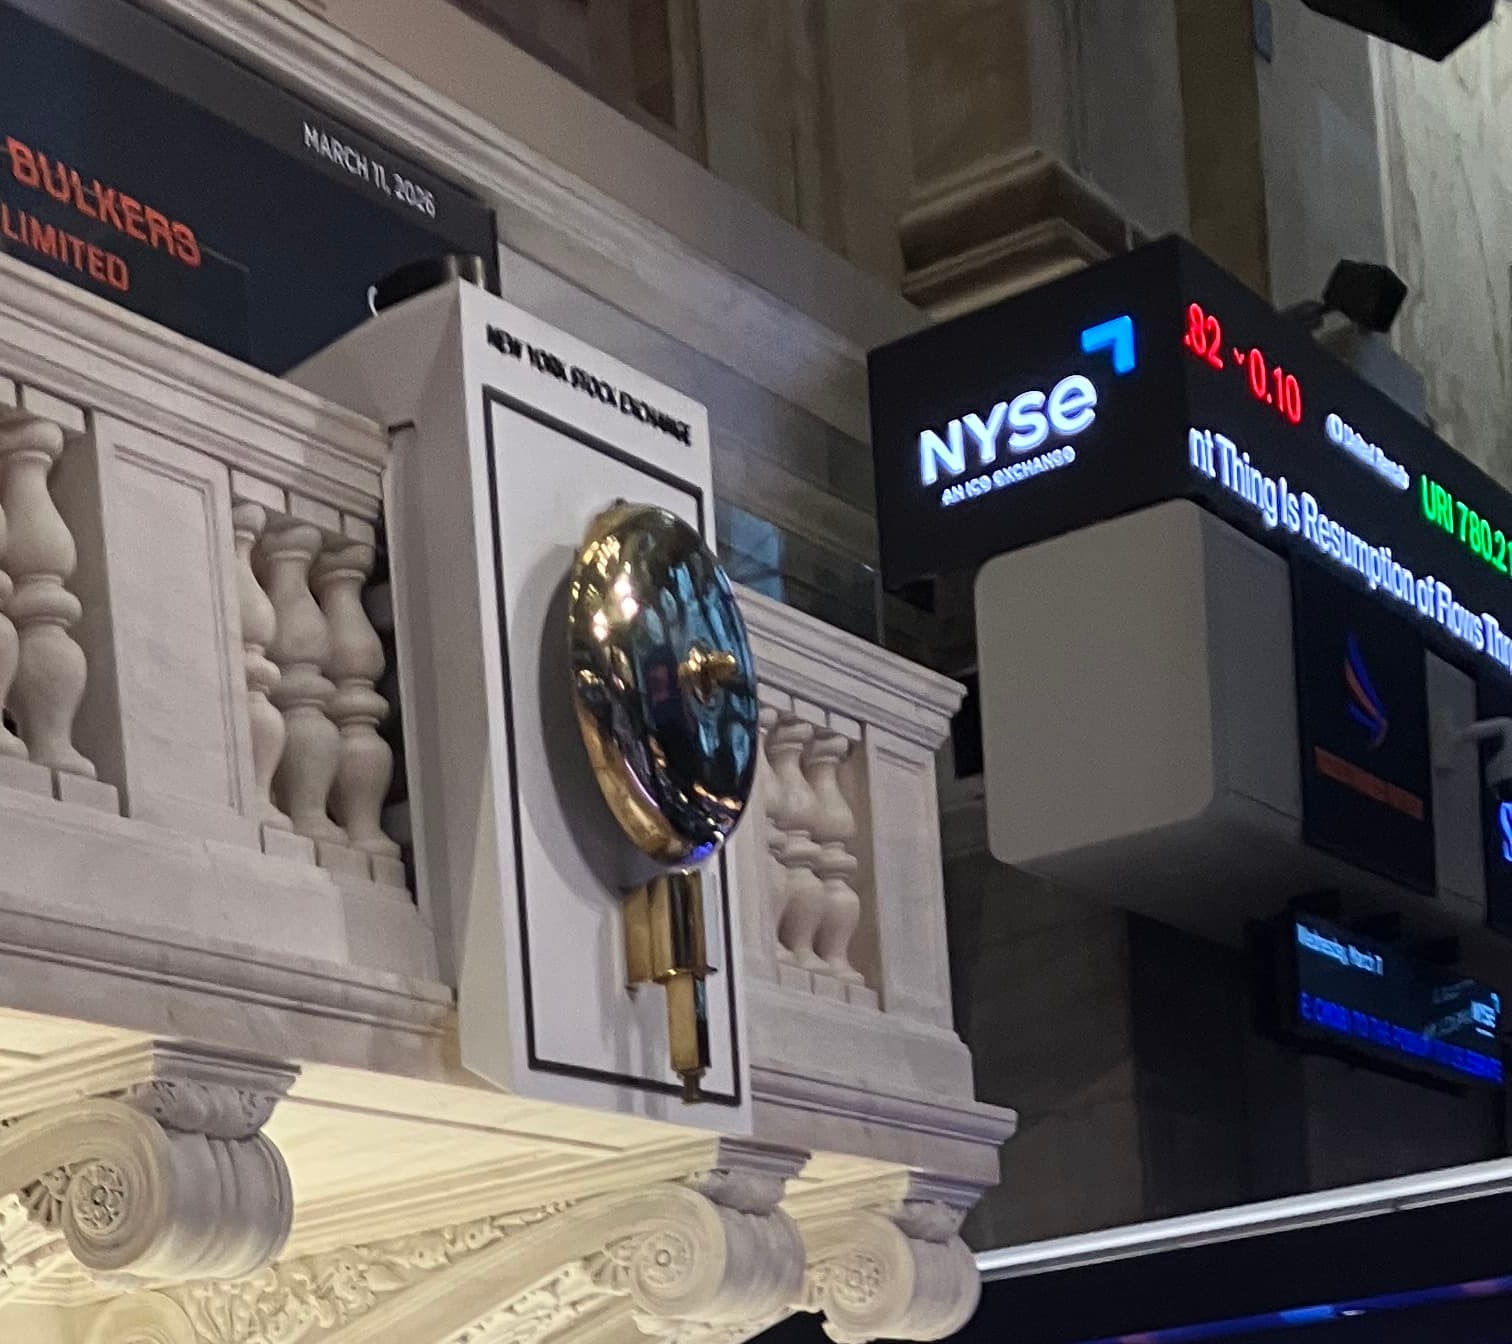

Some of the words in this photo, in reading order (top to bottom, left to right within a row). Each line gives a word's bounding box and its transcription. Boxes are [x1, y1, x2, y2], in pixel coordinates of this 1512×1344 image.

[303, 121, 369, 182] MARCH
[6, 135, 201, 268] BULKERS
[0, 202, 130, 292] LIMITED
[1214, 433, 1278, 530] Thing
[1278, 475, 1301, 535] Is
[1301, 491, 1416, 606] Resumption
[1415, 574, 1436, 618] of
[1421, 473, 1454, 534] URI
